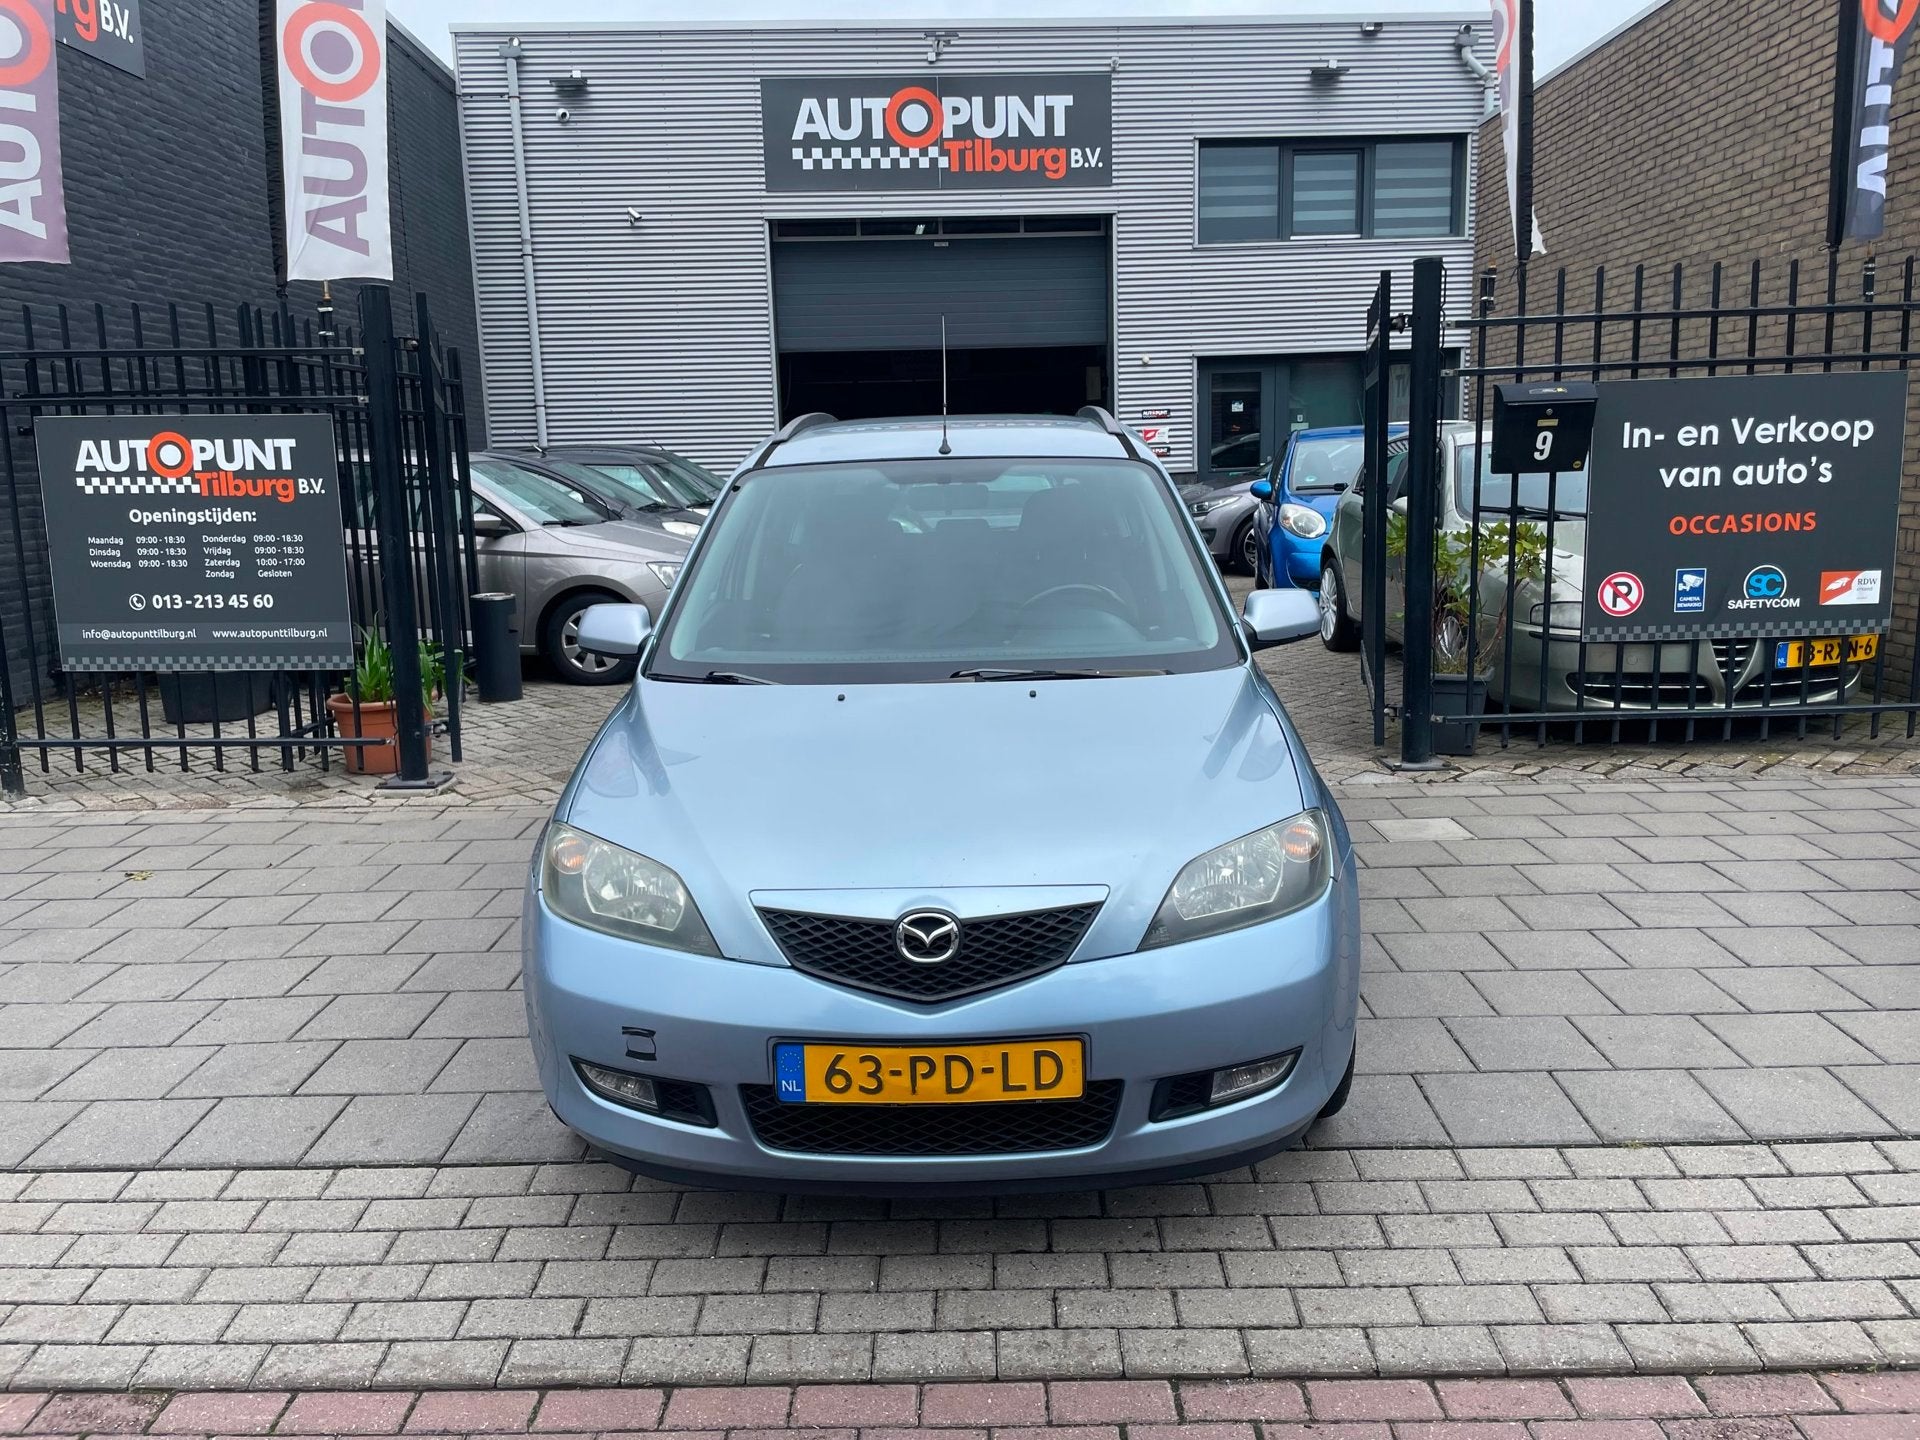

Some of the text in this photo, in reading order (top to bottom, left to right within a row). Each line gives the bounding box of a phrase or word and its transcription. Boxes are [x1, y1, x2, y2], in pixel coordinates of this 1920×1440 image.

[792, 87, 1074, 149] AUTOPUNT
[283, 0, 381, 257] AUTO
[943, 138, 1103, 180] Tilburg B.V.
[1622, 415, 1874, 449] In- en Verkoop
[1533, 431, 1554, 461] 9
[75, 431, 297, 478] AUTOPUNT
[1659, 465, 1721, 488] van
[195, 471, 326, 503] Tilburg B.V.
[128, 508, 257, 525] Openingstijden:
[1669, 511, 1817, 535] OCCASIONS
[87, 535, 124, 547] Maandag
[135, 535, 158, 544] 09:00
[164, 535, 186, 544] 18:30
[202, 534, 247, 545] Donderdag
[253, 534, 275, 543] 09:00
[281, 534, 304, 543] 18:30
[89, 547, 121, 558] Dinsdag
[136, 547, 159, 556] 09:00
[165, 547, 187, 556] 18:30
[203, 546, 232, 557] Vrijdag
[254, 546, 276, 555] 09:00
[283, 546, 304, 555] 18:30
[90, 559, 132, 570] Woensdag
[138, 559, 161, 568] 09:00
[166, 559, 188, 568] 18:30
[204, 558, 241, 568] Zaterdag
[255, 557, 278, 566] 10:00
[284, 557, 306, 566] 17:00
[205, 569, 293, 580] Zondag Gesloten
[1857, 577, 1878, 585] RDW
[228, 594, 249, 608] 45
[252, 593, 274, 608] 60
[1727, 596, 1801, 610] SAFETYCOM
[82, 627, 328, 640] info@autopunttilburg.nl www.autopunttilburg.nl
[824, 1049, 1064, 1095] 63-PD-LD
[781, 1079, 802, 1092] NL
